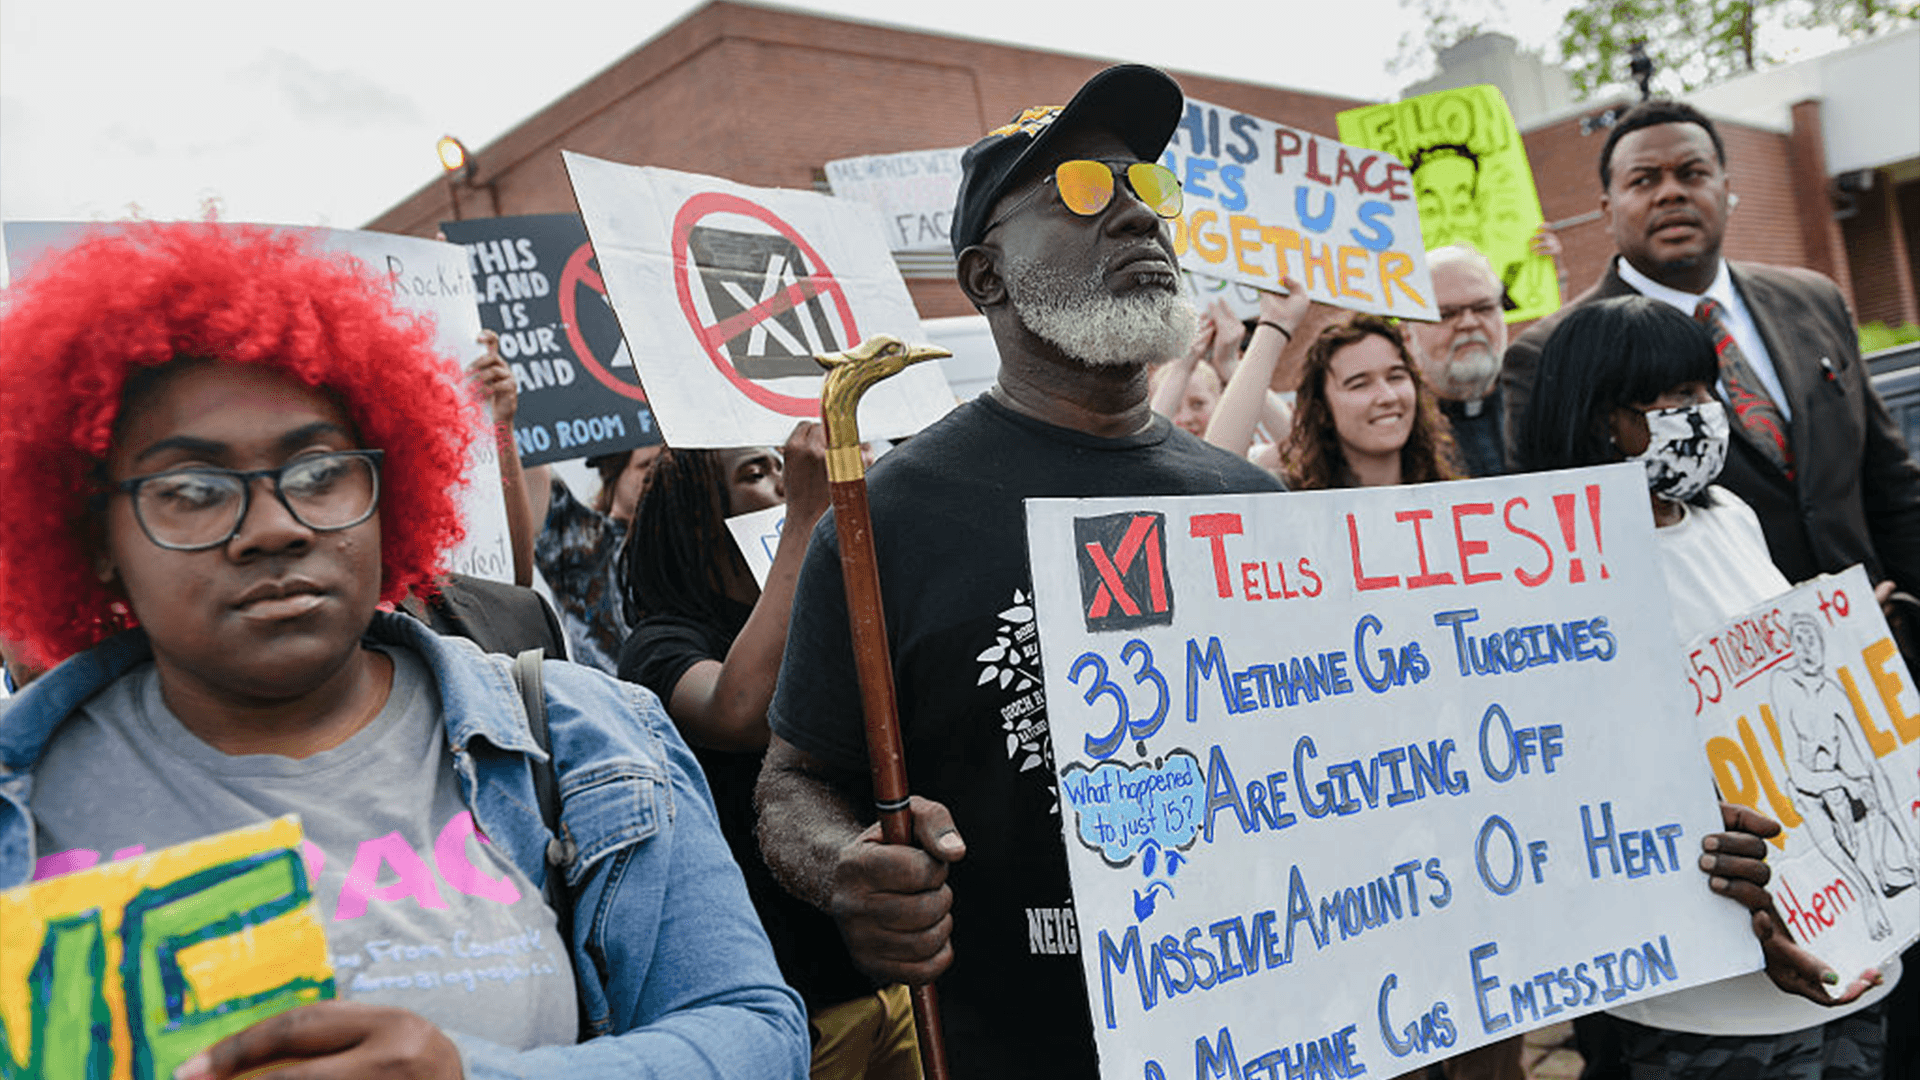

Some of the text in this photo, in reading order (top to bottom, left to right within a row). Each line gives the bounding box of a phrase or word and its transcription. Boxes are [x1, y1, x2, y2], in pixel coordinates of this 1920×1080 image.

[1172, 103, 1411, 201] HIS PLACE
[896, 210, 953, 246] FAC
[1294, 186, 1396, 253] US
[477, 271, 550, 303] AND
[500, 302, 530, 330] IS
[511, 358, 575, 395] AND
[514, 424, 551, 455] NO
[555, 414, 626, 449] ROOM
[637, 409, 656, 433] F
[1189, 512, 1323, 602] TELLS
[1345, 484, 1611, 592] LIES!!
[1817, 588, 1851, 627] to
[1067, 607, 1618, 760] 33 METHANE GAS TURBINES
[1477, 702, 1564, 783] OFF
[1063, 758, 1194, 814] What happened
[1094, 795, 1195, 848] to just 15?
[1475, 814, 1549, 896] OF
[1579, 801, 1684, 879] HEAT
[1026, 906, 1078, 955] NEIG
[1777, 874, 1856, 944] them
[1377, 973, 1458, 1058] GAS
[1469, 934, 1679, 1035] EMISSION
